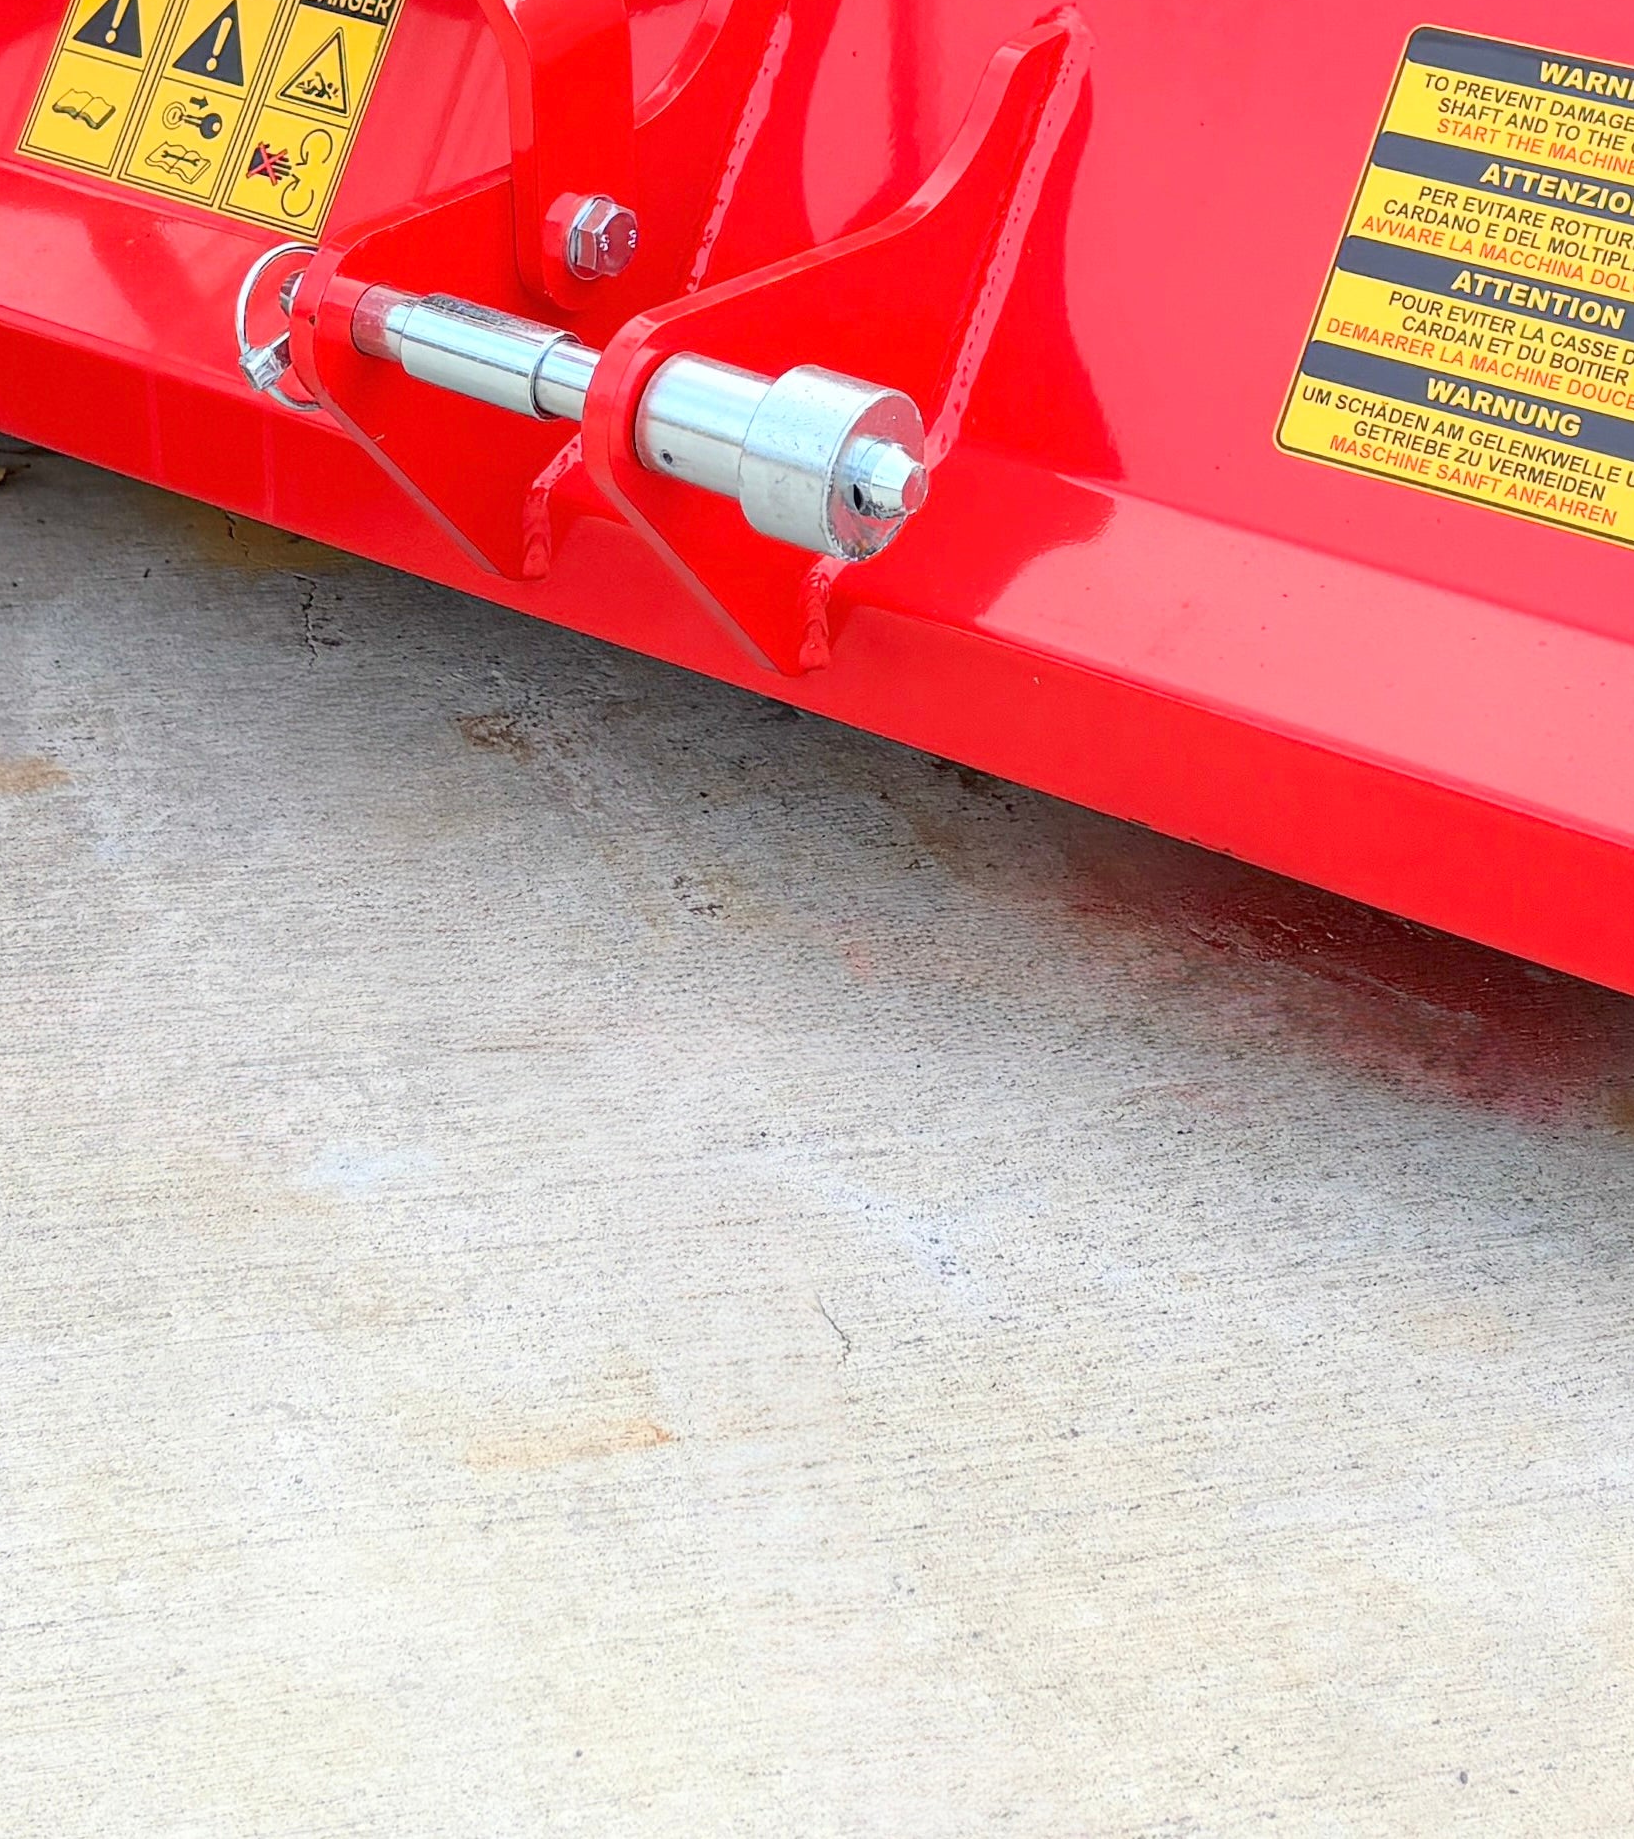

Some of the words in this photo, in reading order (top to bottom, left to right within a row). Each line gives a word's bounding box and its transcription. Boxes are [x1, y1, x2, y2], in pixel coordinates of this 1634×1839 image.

[1425, 73, 1449, 91] TO
[1454, 80, 1546, 111] PREVENT
[1437, 118, 1500, 144] START
[1505, 133, 1545, 154] THE
[1438, 97, 1503, 124] SHAFT
[1505, 113, 1548, 134] AND
[1555, 122, 1580, 141] TO
[1587, 129, 1626, 151] THE
[1384, 199, 1480, 234] CARDANO
[1485, 223, 1500, 239] E
[1503, 227, 1541, 250] DEL
[1418, 186, 1458, 208] PER
[1463, 196, 1547, 228] EVITARE
[1361, 215, 1446, 246] AVVIARE
[1449, 236, 1473, 254] LA
[1478, 243, 1584, 281] MACCHINA
[1388, 291, 1443, 318] POUR
[1447, 305, 1516, 336] EVITER
[1520, 323, 1544, 344] LA
[1550, 332, 1619, 361] CASSE
[1451, 270, 1625, 329] ATTENTION
[1326, 318, 1435, 359] DEMARRER
[1439, 346, 1464, 366] LA
[1469, 354, 1563, 391] MACHINE
[1402, 316, 1484, 350] CARDAN
[1487, 338, 1514, 356] ET
[1517, 344, 1546, 364] DU
[1549, 353, 1629, 386] BOITIER
[1302, 385, 1332, 406] UM
[1335, 395, 1430, 431] SCHÄDEN
[1431, 421, 1465, 441] AM
[1469, 430, 1621, 483] GELENKWELLE
[1426, 377, 1582, 437] WARNUNG
[1330, 434, 1433, 475] MASCHINE
[1436, 464, 1503, 493] SANFT
[1504, 483, 1617, 527] ANFAHREN
[1354, 420, 1452, 459] GETRIEBE
[1454, 447, 1483, 466] ZU
[1489, 454, 1606, 501] VERMEIDEN
